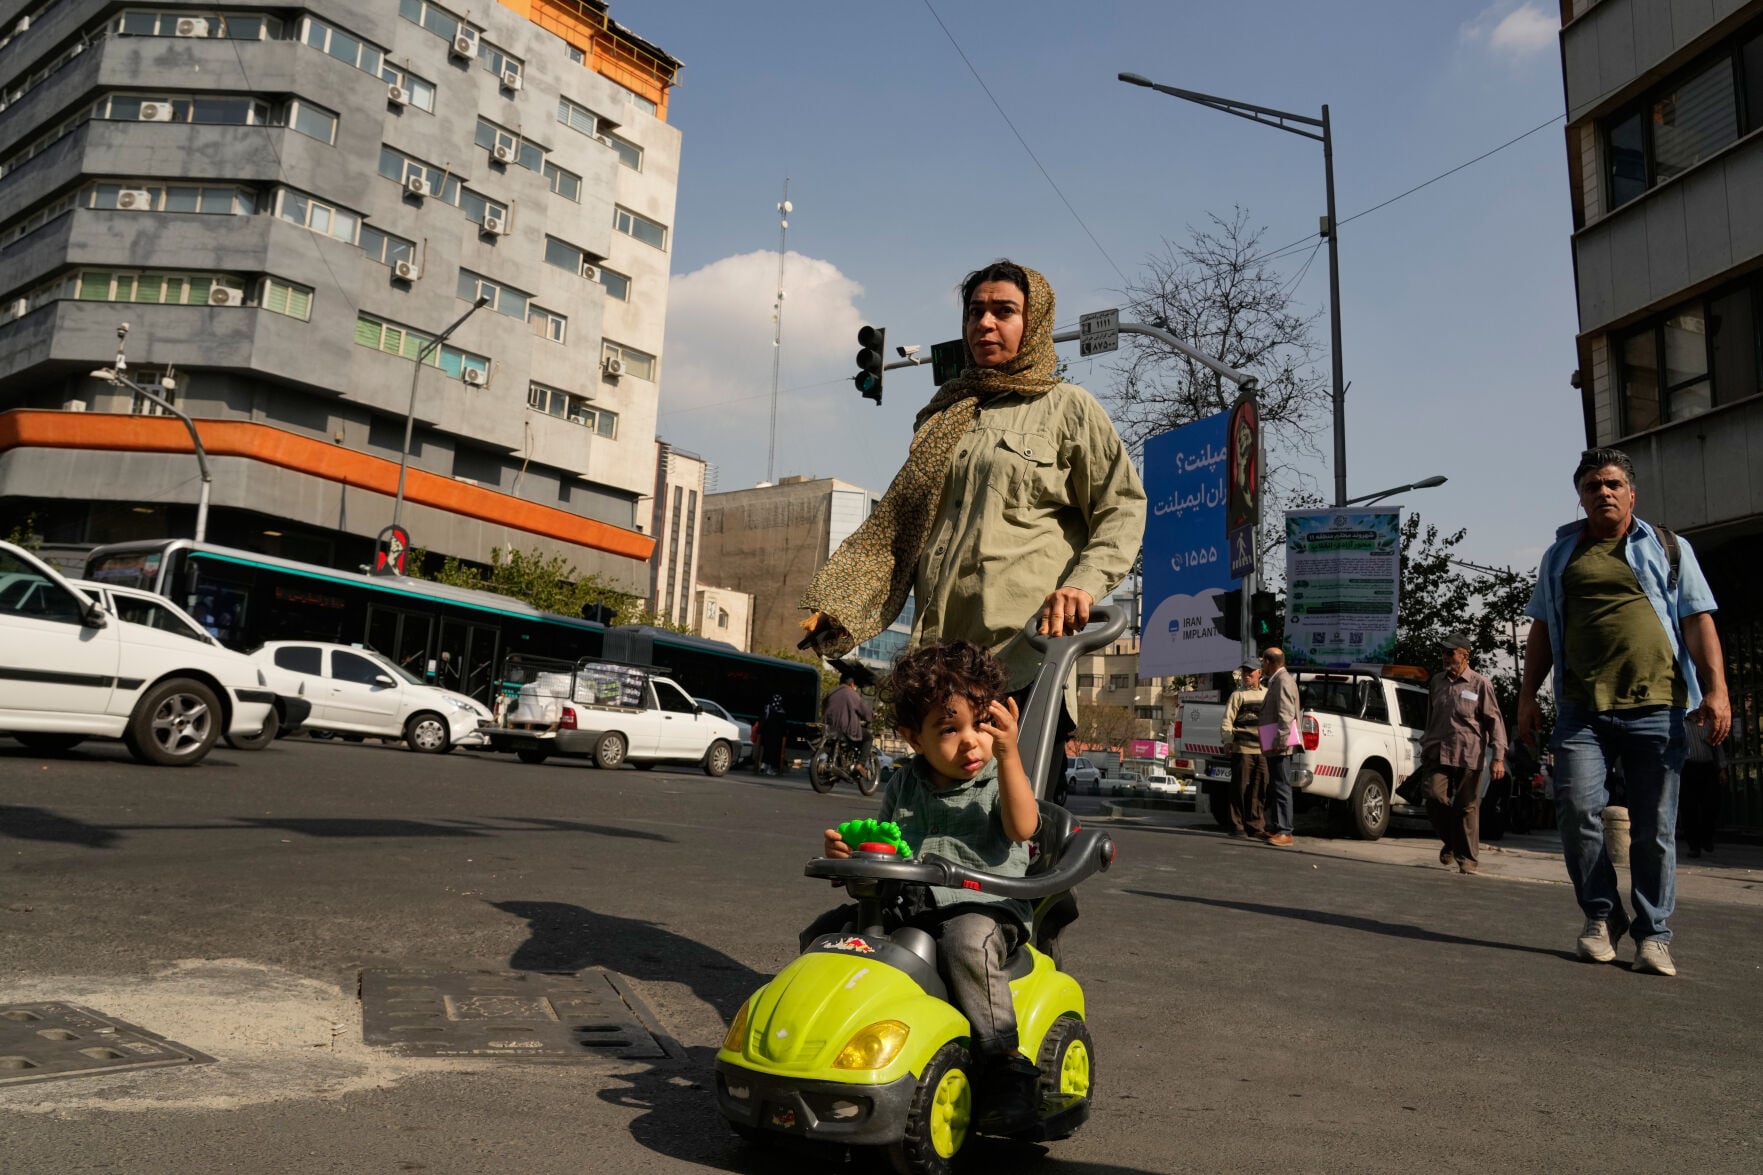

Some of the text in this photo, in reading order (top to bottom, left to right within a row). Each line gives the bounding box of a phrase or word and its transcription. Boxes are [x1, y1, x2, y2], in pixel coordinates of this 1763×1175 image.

[1093, 340, 1116, 351] ۸۷۵۰۰
[1154, 483, 1205, 518] ایمپلنت
[1184, 546, 1218, 568] ۱۵۵۵
[1183, 616, 1202, 628] IRAN
[1183, 627, 1217, 641] IMPLANT
